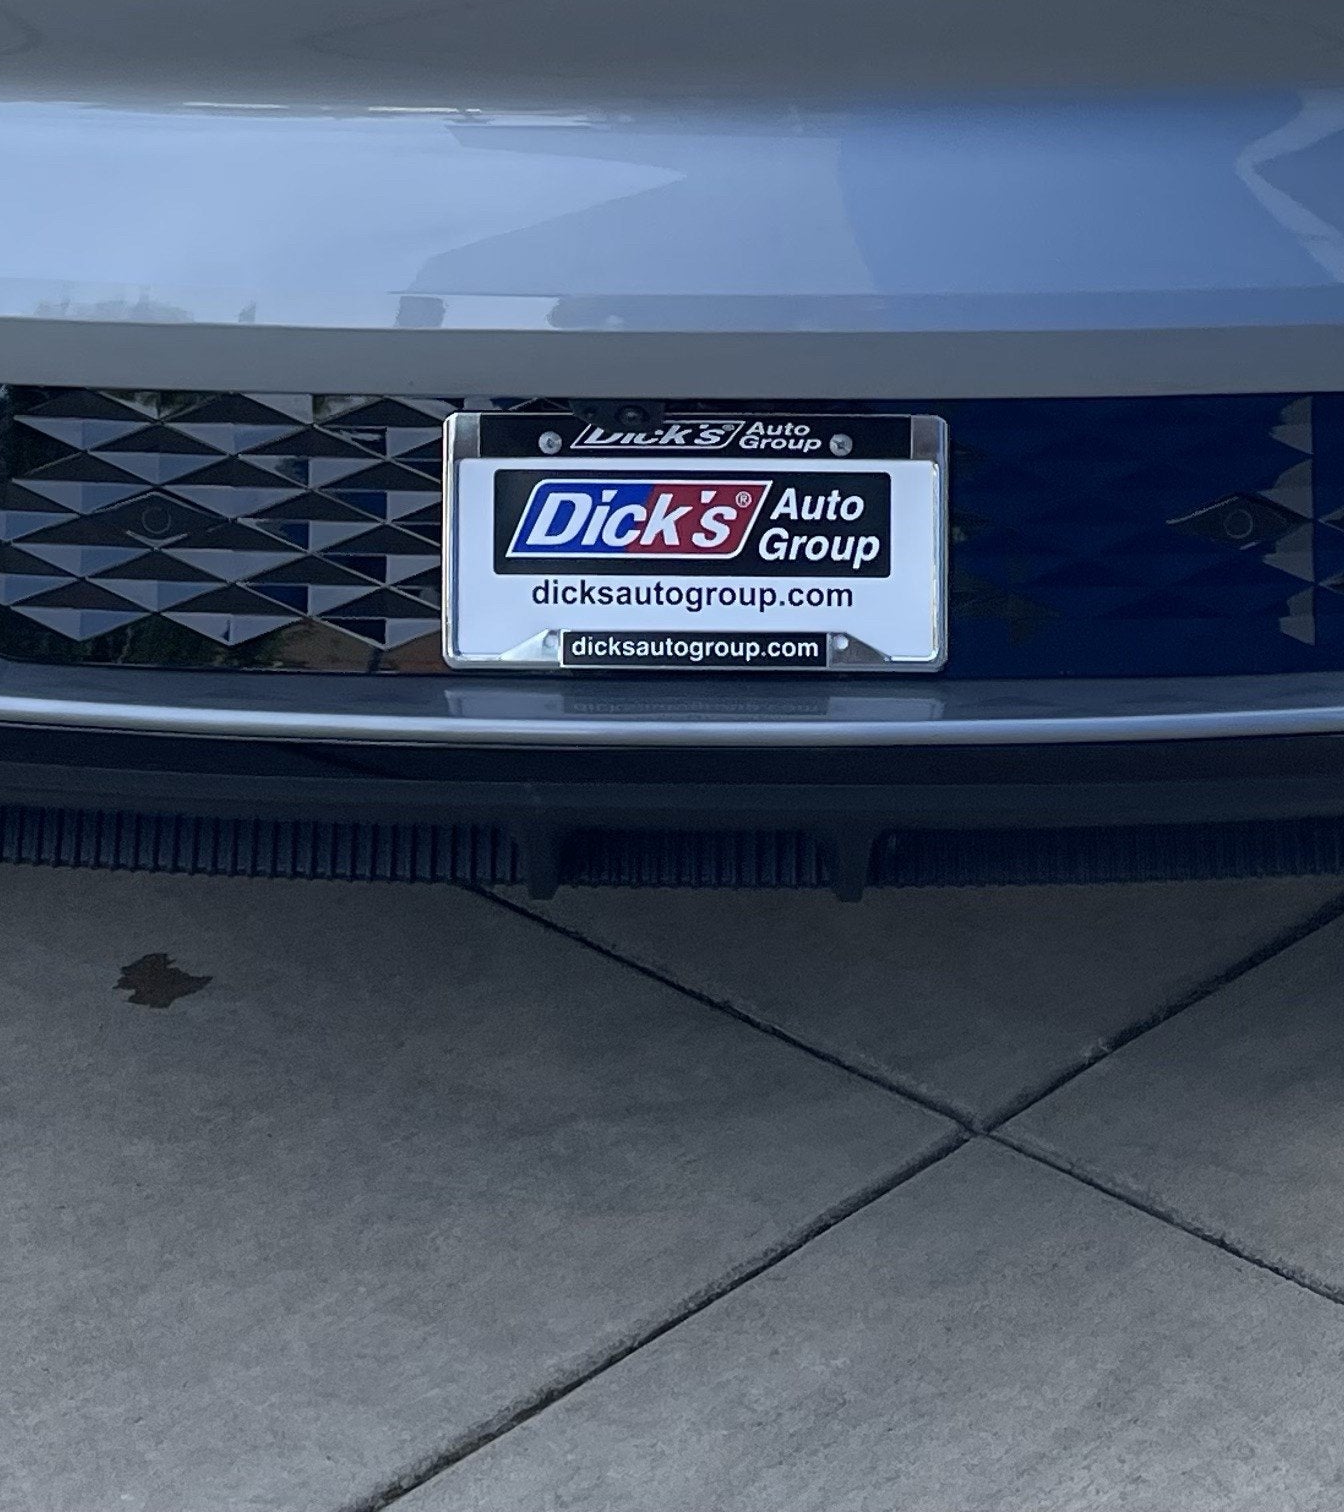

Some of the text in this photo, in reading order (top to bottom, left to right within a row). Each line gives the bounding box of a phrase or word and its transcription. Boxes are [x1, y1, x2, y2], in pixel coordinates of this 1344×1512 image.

[738, 435, 823, 454] Group
[745, 420, 811, 437] Auto
[525, 488, 738, 548] Dick's
[770, 488, 865, 522] Auto
[758, 529, 880, 569] Group
[531, 579, 854, 612] dicksautogroup.com
[570, 636, 820, 661] dicksautogroup.com
